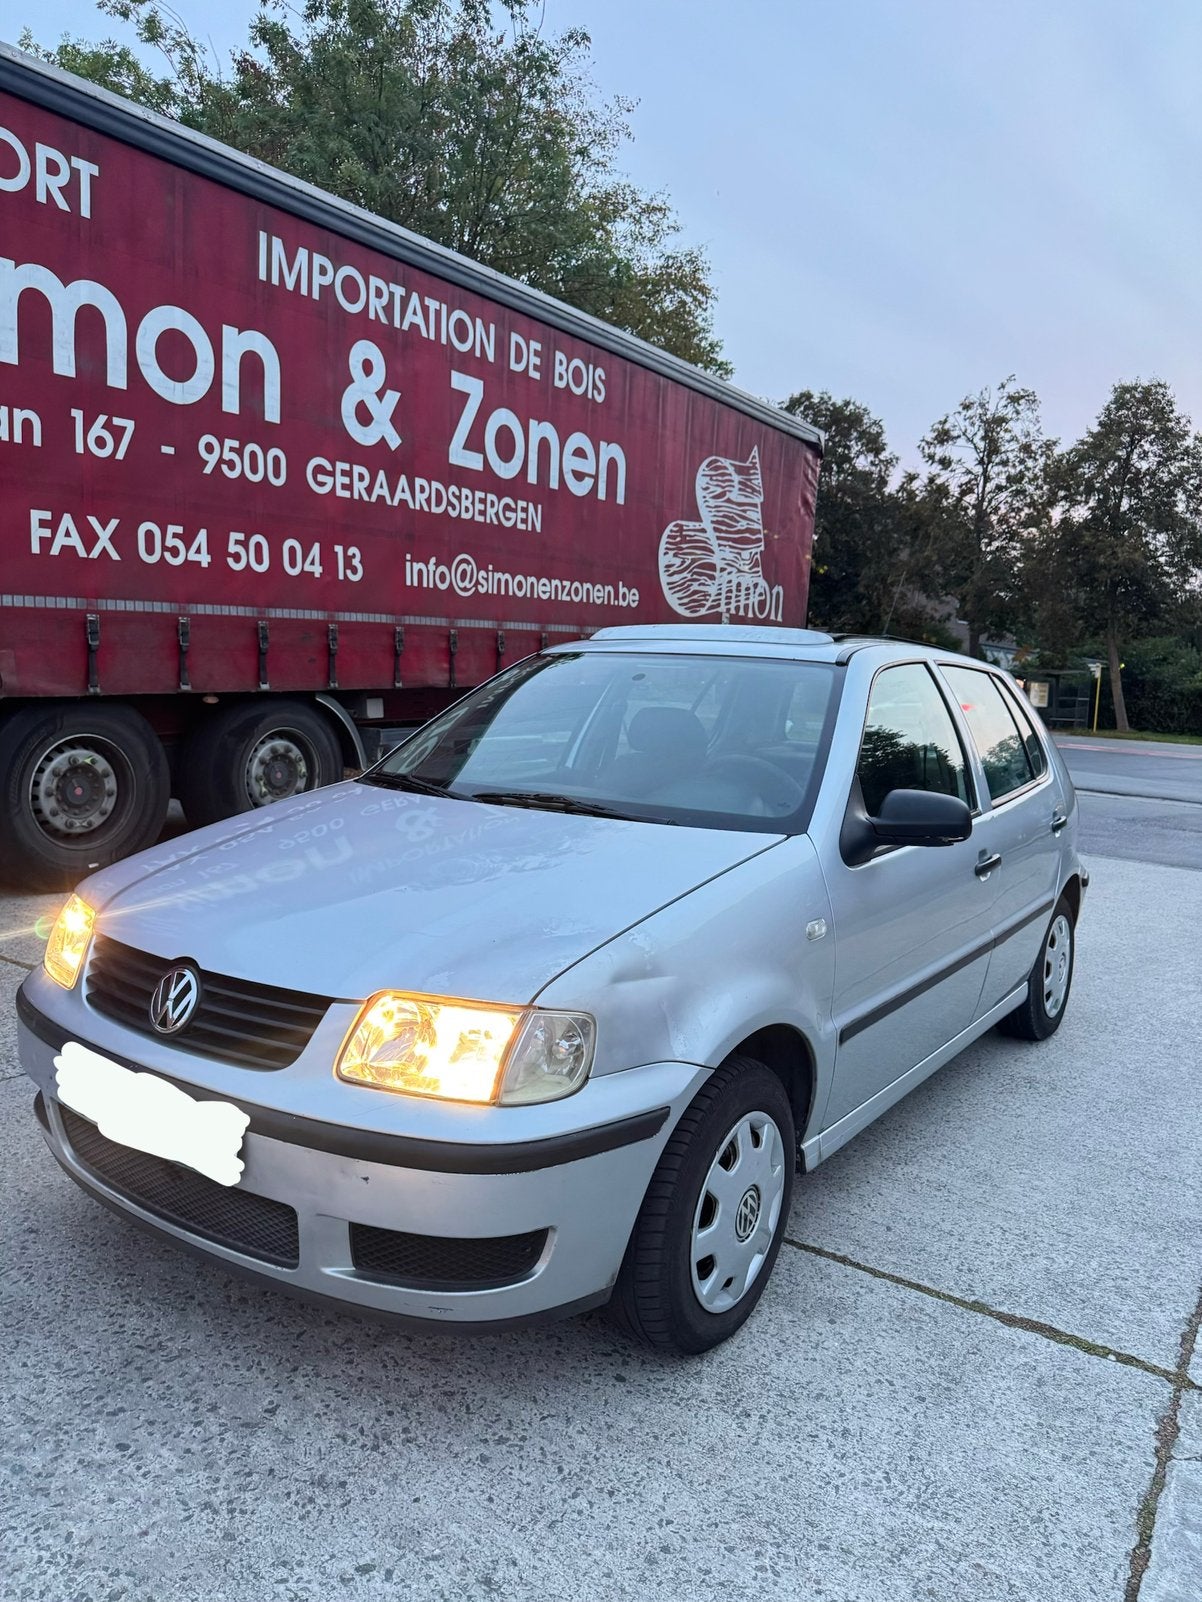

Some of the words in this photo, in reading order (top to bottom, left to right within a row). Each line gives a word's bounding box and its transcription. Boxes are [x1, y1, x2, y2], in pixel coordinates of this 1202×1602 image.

[258, 231, 496, 363] IMPORTATION
[509, 332, 542, 380] DE
[553, 350, 606, 404] BOIS
[71, 409, 135, 461] 167
[198, 434, 287, 487] 9500
[306, 456, 542, 532] GERAARDSBERGEN
[340, 340, 402, 452] &
[448, 370, 627, 505] Zonen
[30, 509, 122, 560] FAX
[137, 521, 211, 568] 054
[227, 532, 270, 573] 50
[282, 538, 323, 578] 04
[333, 545, 363, 582] 13
[405, 552, 640, 608] info@simonenzonen.be
